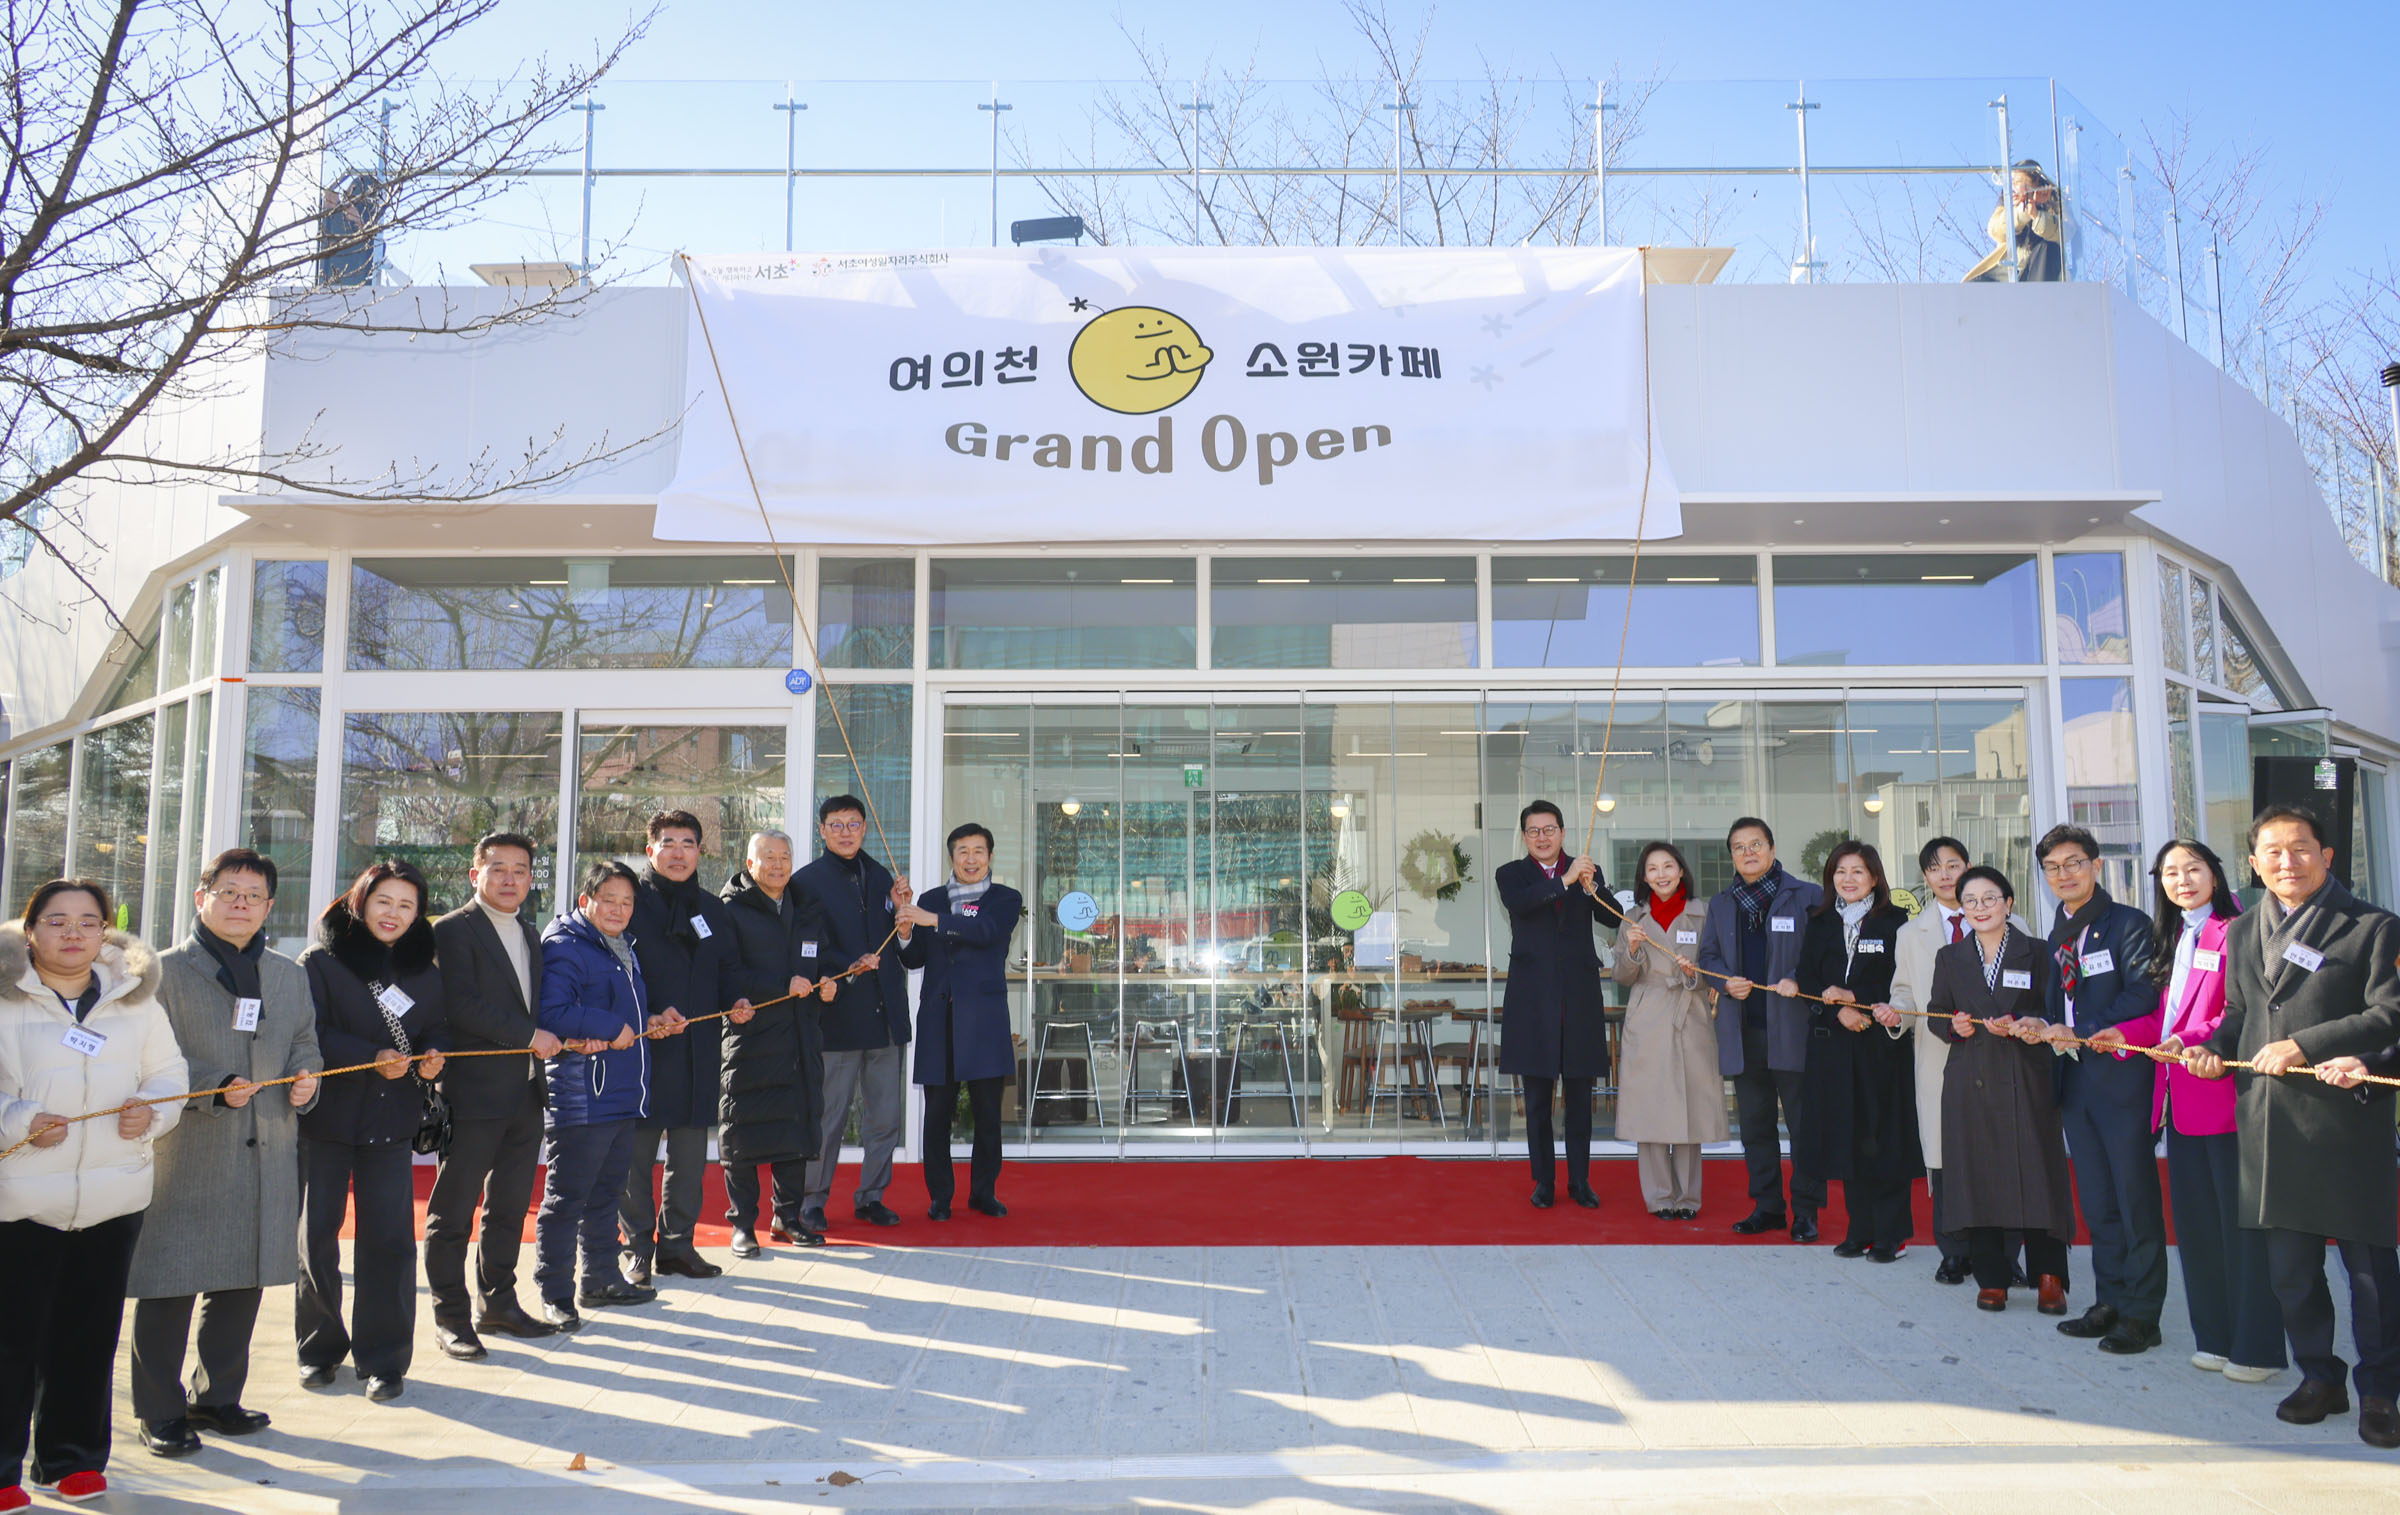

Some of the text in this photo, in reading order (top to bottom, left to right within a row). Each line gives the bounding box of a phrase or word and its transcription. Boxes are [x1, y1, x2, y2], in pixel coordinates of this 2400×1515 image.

[755, 263, 789, 281] 서초
[889, 342, 1441, 391] 여의천 소원카페
[945, 414, 1391, 485] Grand Open
[790, 676, 807, 686] ADT
